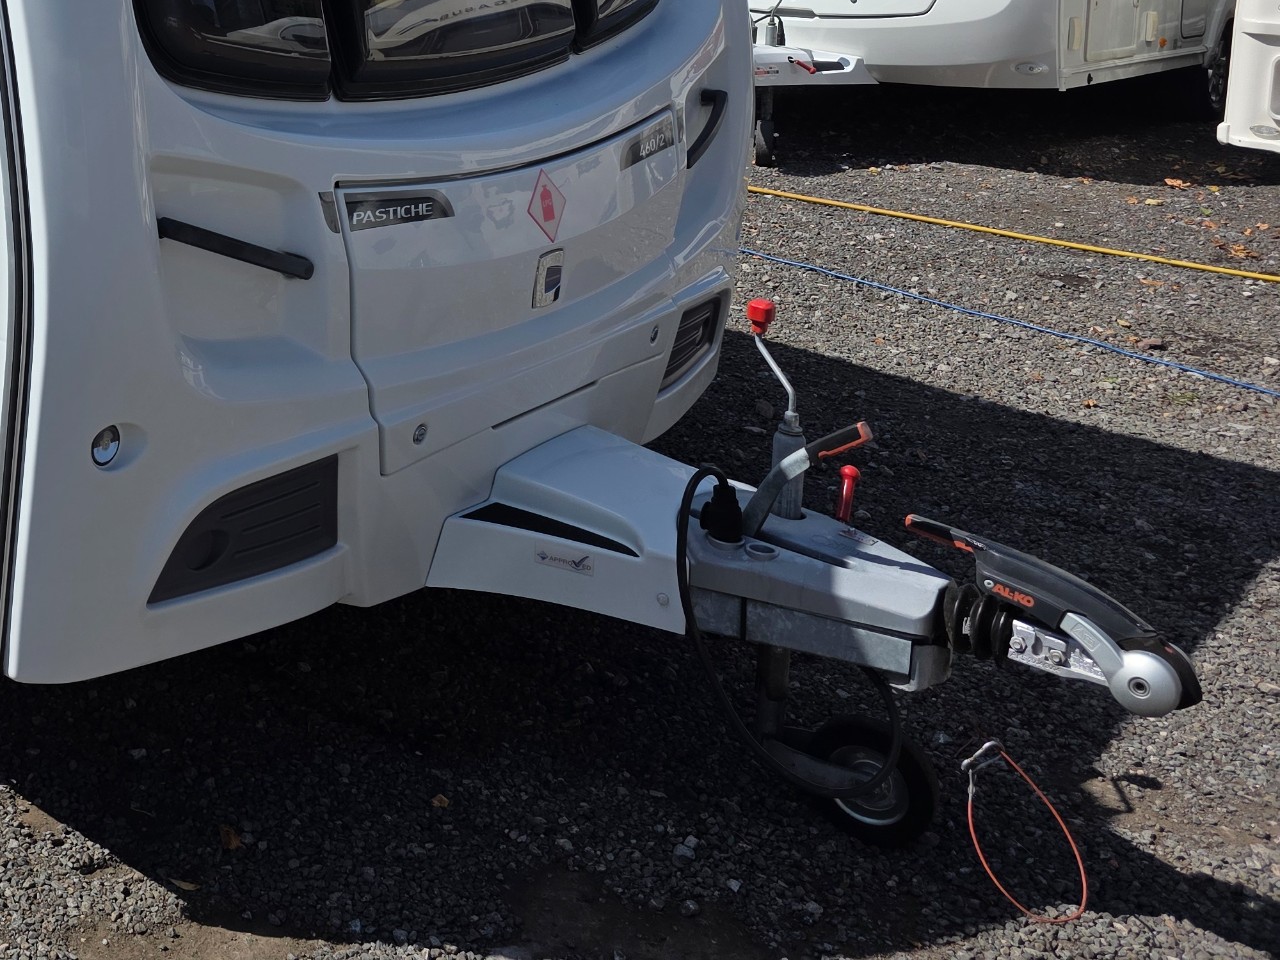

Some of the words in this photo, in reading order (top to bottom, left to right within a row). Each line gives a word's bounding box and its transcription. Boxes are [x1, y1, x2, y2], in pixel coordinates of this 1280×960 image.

[639, 133, 666, 158] 460/2
[352, 201, 434, 225] PASTICHE
[991, 582, 1036, 608] AL-KO
